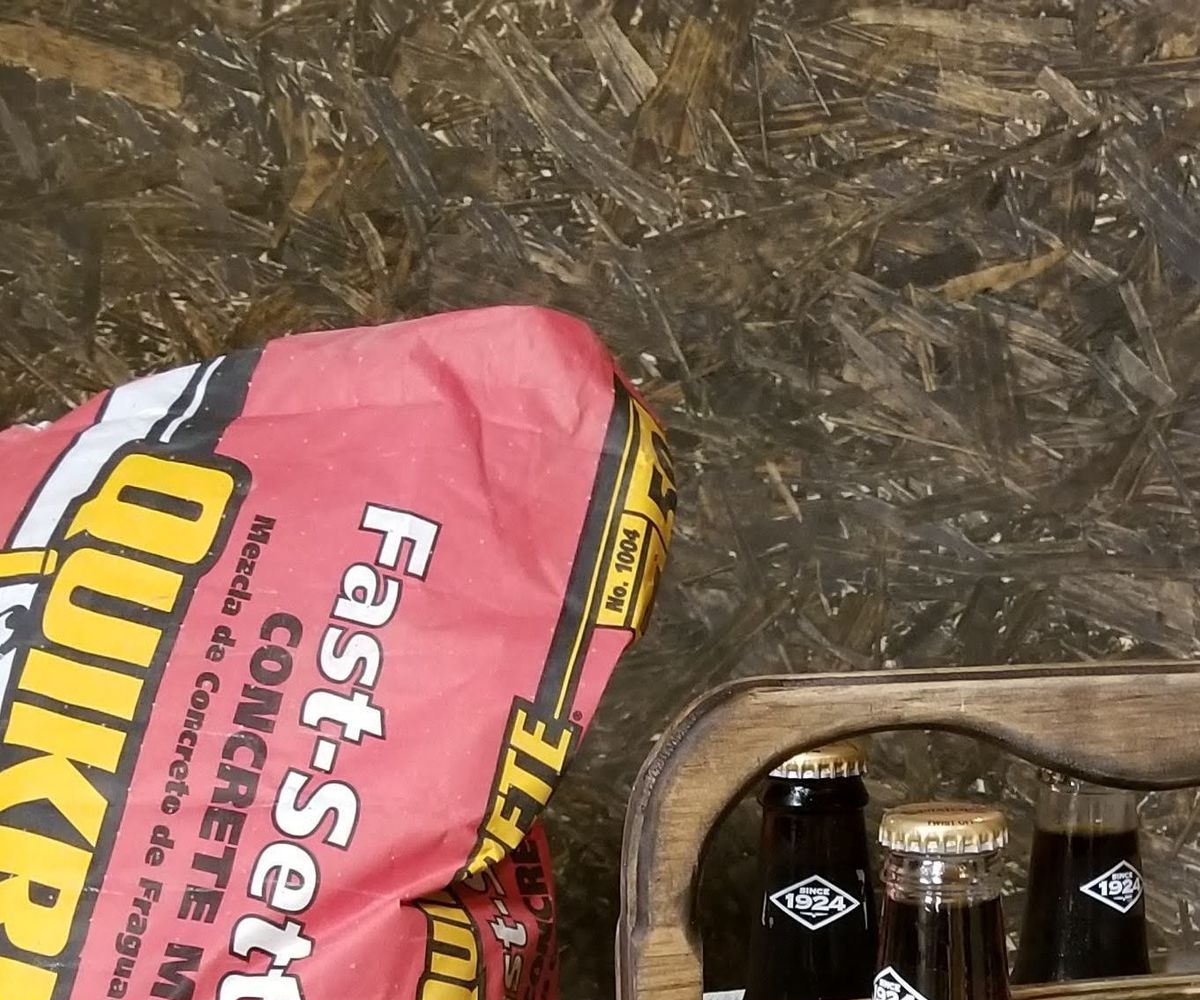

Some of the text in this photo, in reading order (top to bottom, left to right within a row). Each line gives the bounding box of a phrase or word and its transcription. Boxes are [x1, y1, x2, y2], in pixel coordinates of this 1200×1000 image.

[223, 514, 276, 616] Mezcla
[605, 528, 640, 613] No. 1004
[207, 625, 236, 662] de
[162, 672, 220, 814] Concreto
[177, 612, 303, 925] CONCRETE
[145, 824, 175, 866] de
[785, 893, 846, 911] 1924
[799, 887, 830, 895] SINCE
